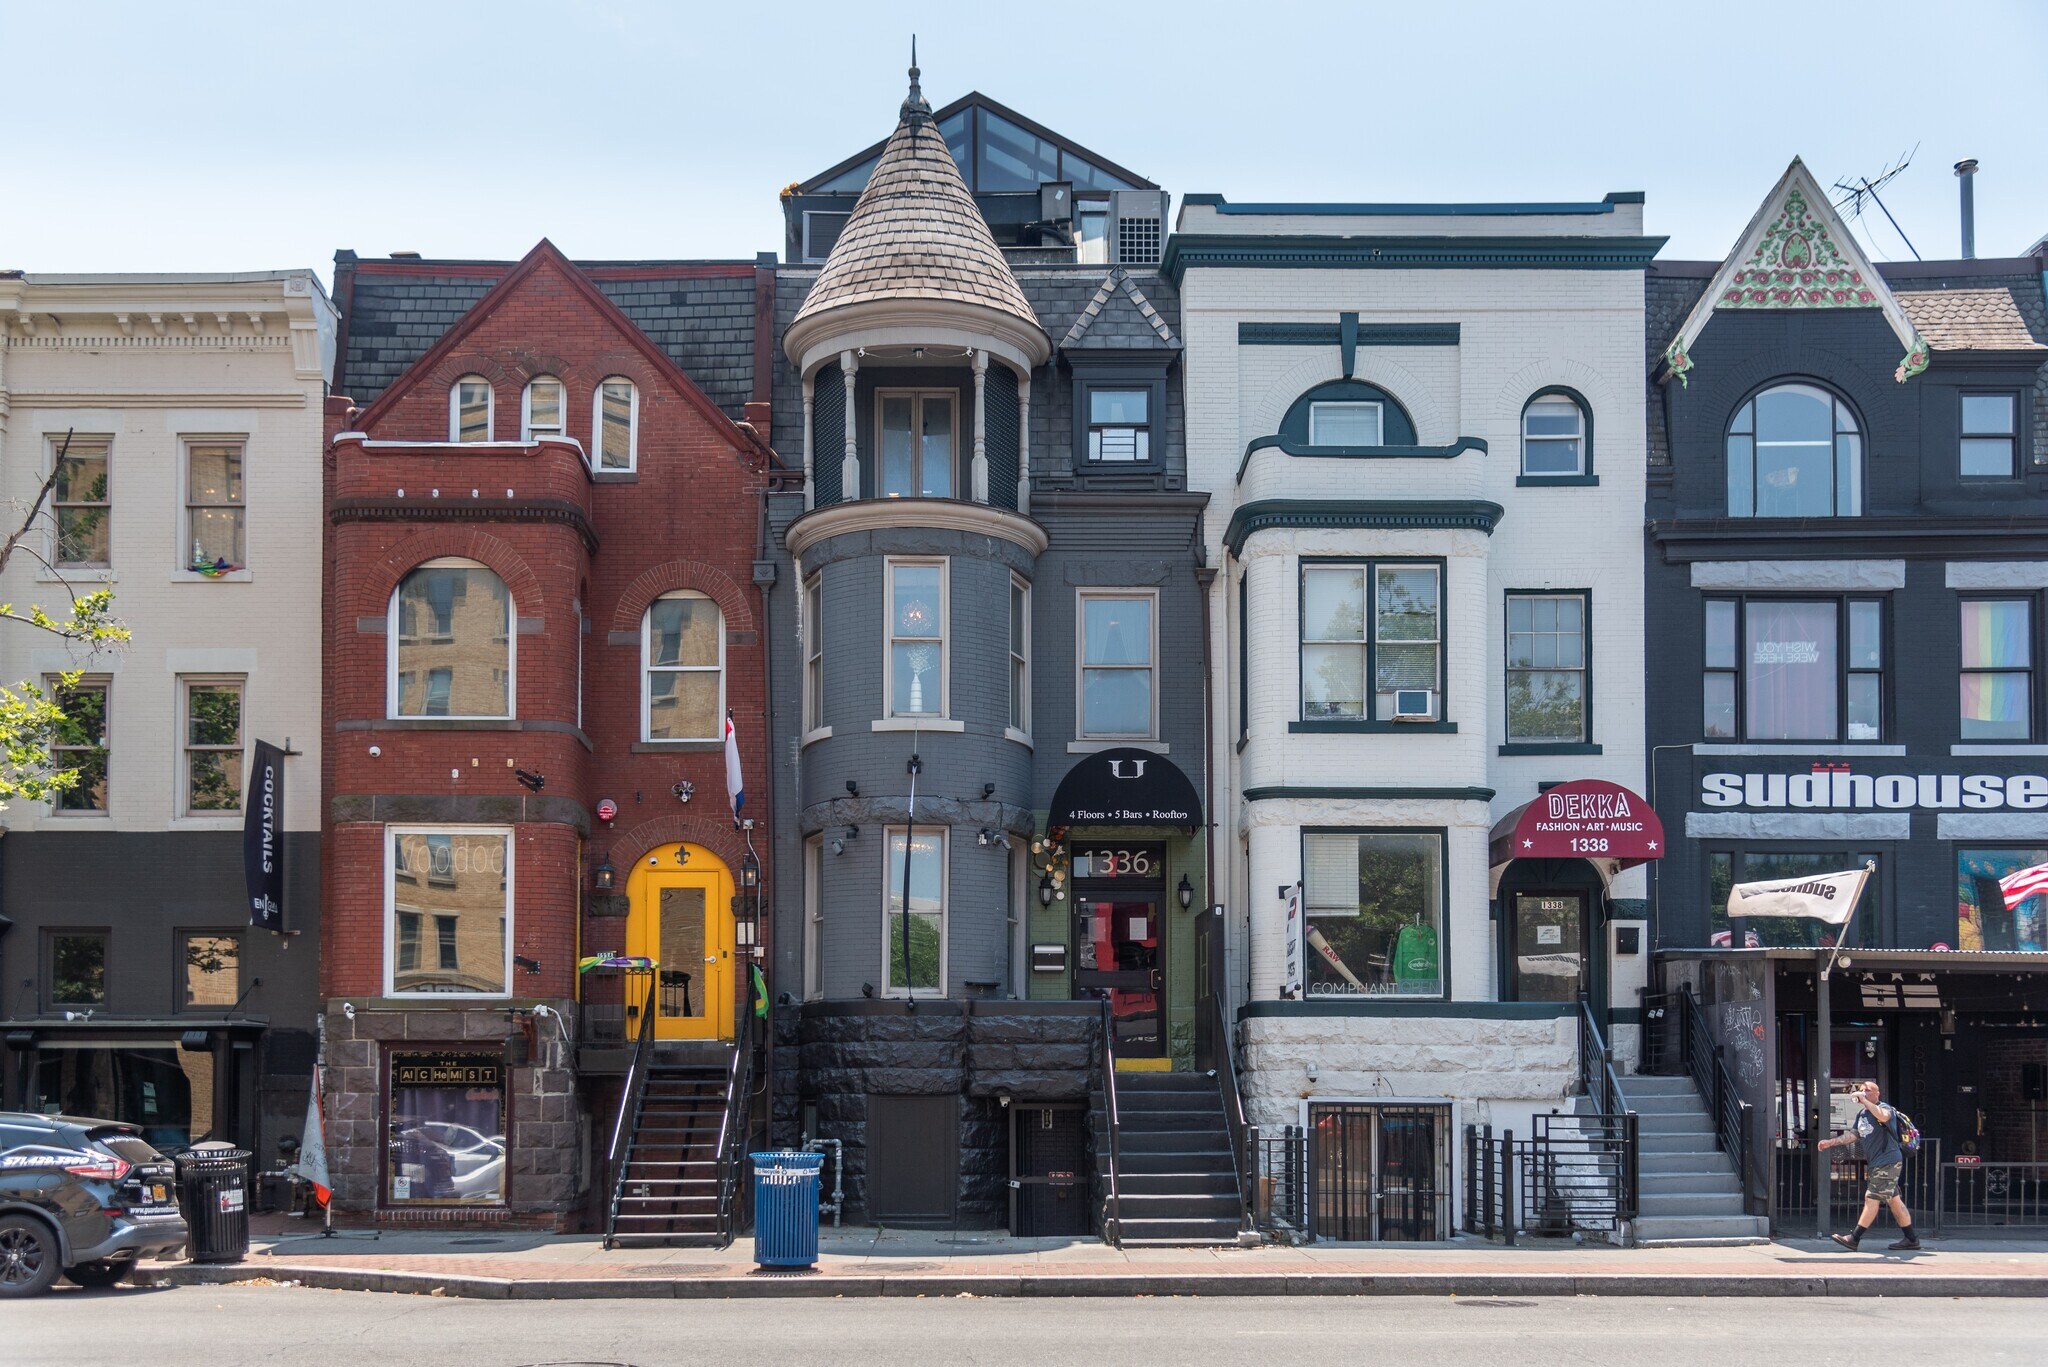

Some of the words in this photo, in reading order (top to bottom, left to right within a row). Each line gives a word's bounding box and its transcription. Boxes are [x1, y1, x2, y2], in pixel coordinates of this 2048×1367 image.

[1108, 759, 1148, 779] U
[1701, 767, 2048, 808] sudhouse
[1069, 810, 1076, 819] 4
[1077, 810, 1105, 819] Floors
[1114, 810, 1121, 819] 5
[1122, 810, 1143, 819] Bars
[1548, 792, 1631, 820] DEKKA
[263, 765, 274, 875] COCKTAILS
[1536, 822, 1580, 831] FASHION
[1586, 822, 1605, 831] ART
[1610, 822, 1643, 831] MUSIC
[1570, 838, 1609, 852] 1338
[1084, 849, 1150, 874] 1336
[1543, 901, 1563, 909] 1338
[1322, 945, 1341, 962] RAW
[1401, 980, 1440, 994] OPEN
